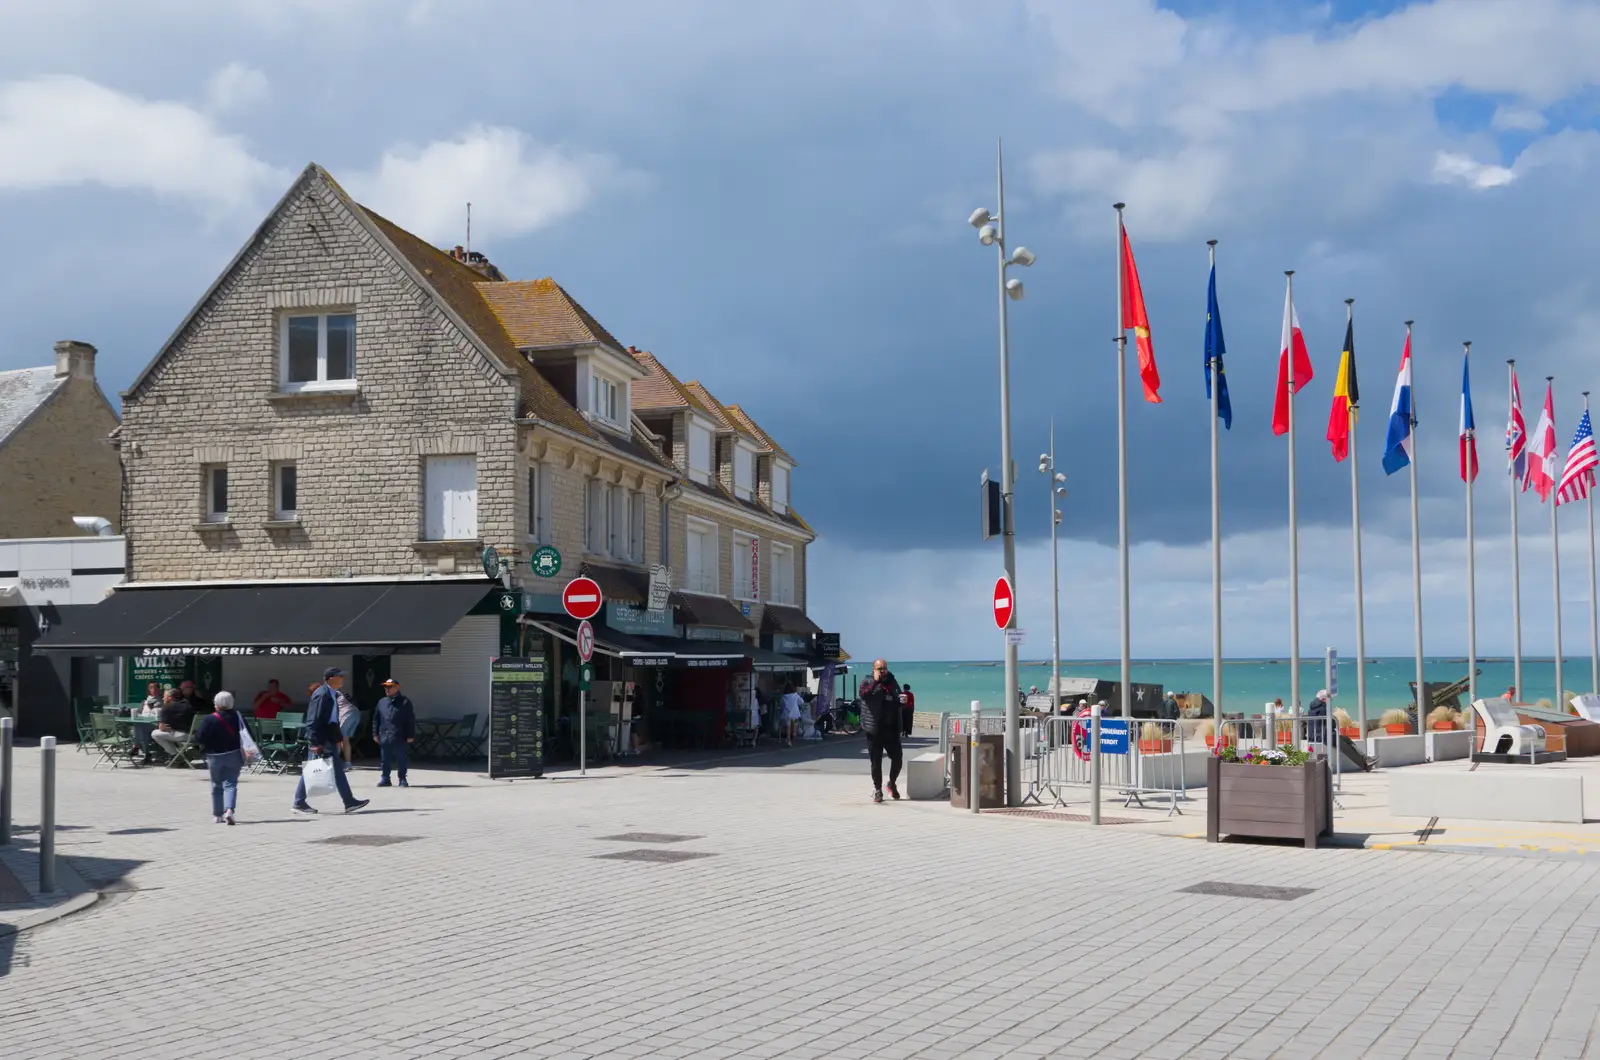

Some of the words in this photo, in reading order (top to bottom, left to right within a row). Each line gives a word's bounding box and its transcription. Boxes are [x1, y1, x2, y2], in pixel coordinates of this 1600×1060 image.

[536, 565, 556, 575] WILLYS
[751, 538, 759, 593] CHAMBRES
[142, 646, 254, 656] SANDWICHERIE
[270, 646, 320, 655] SNACK
[133, 656, 187, 668] WILLYS
